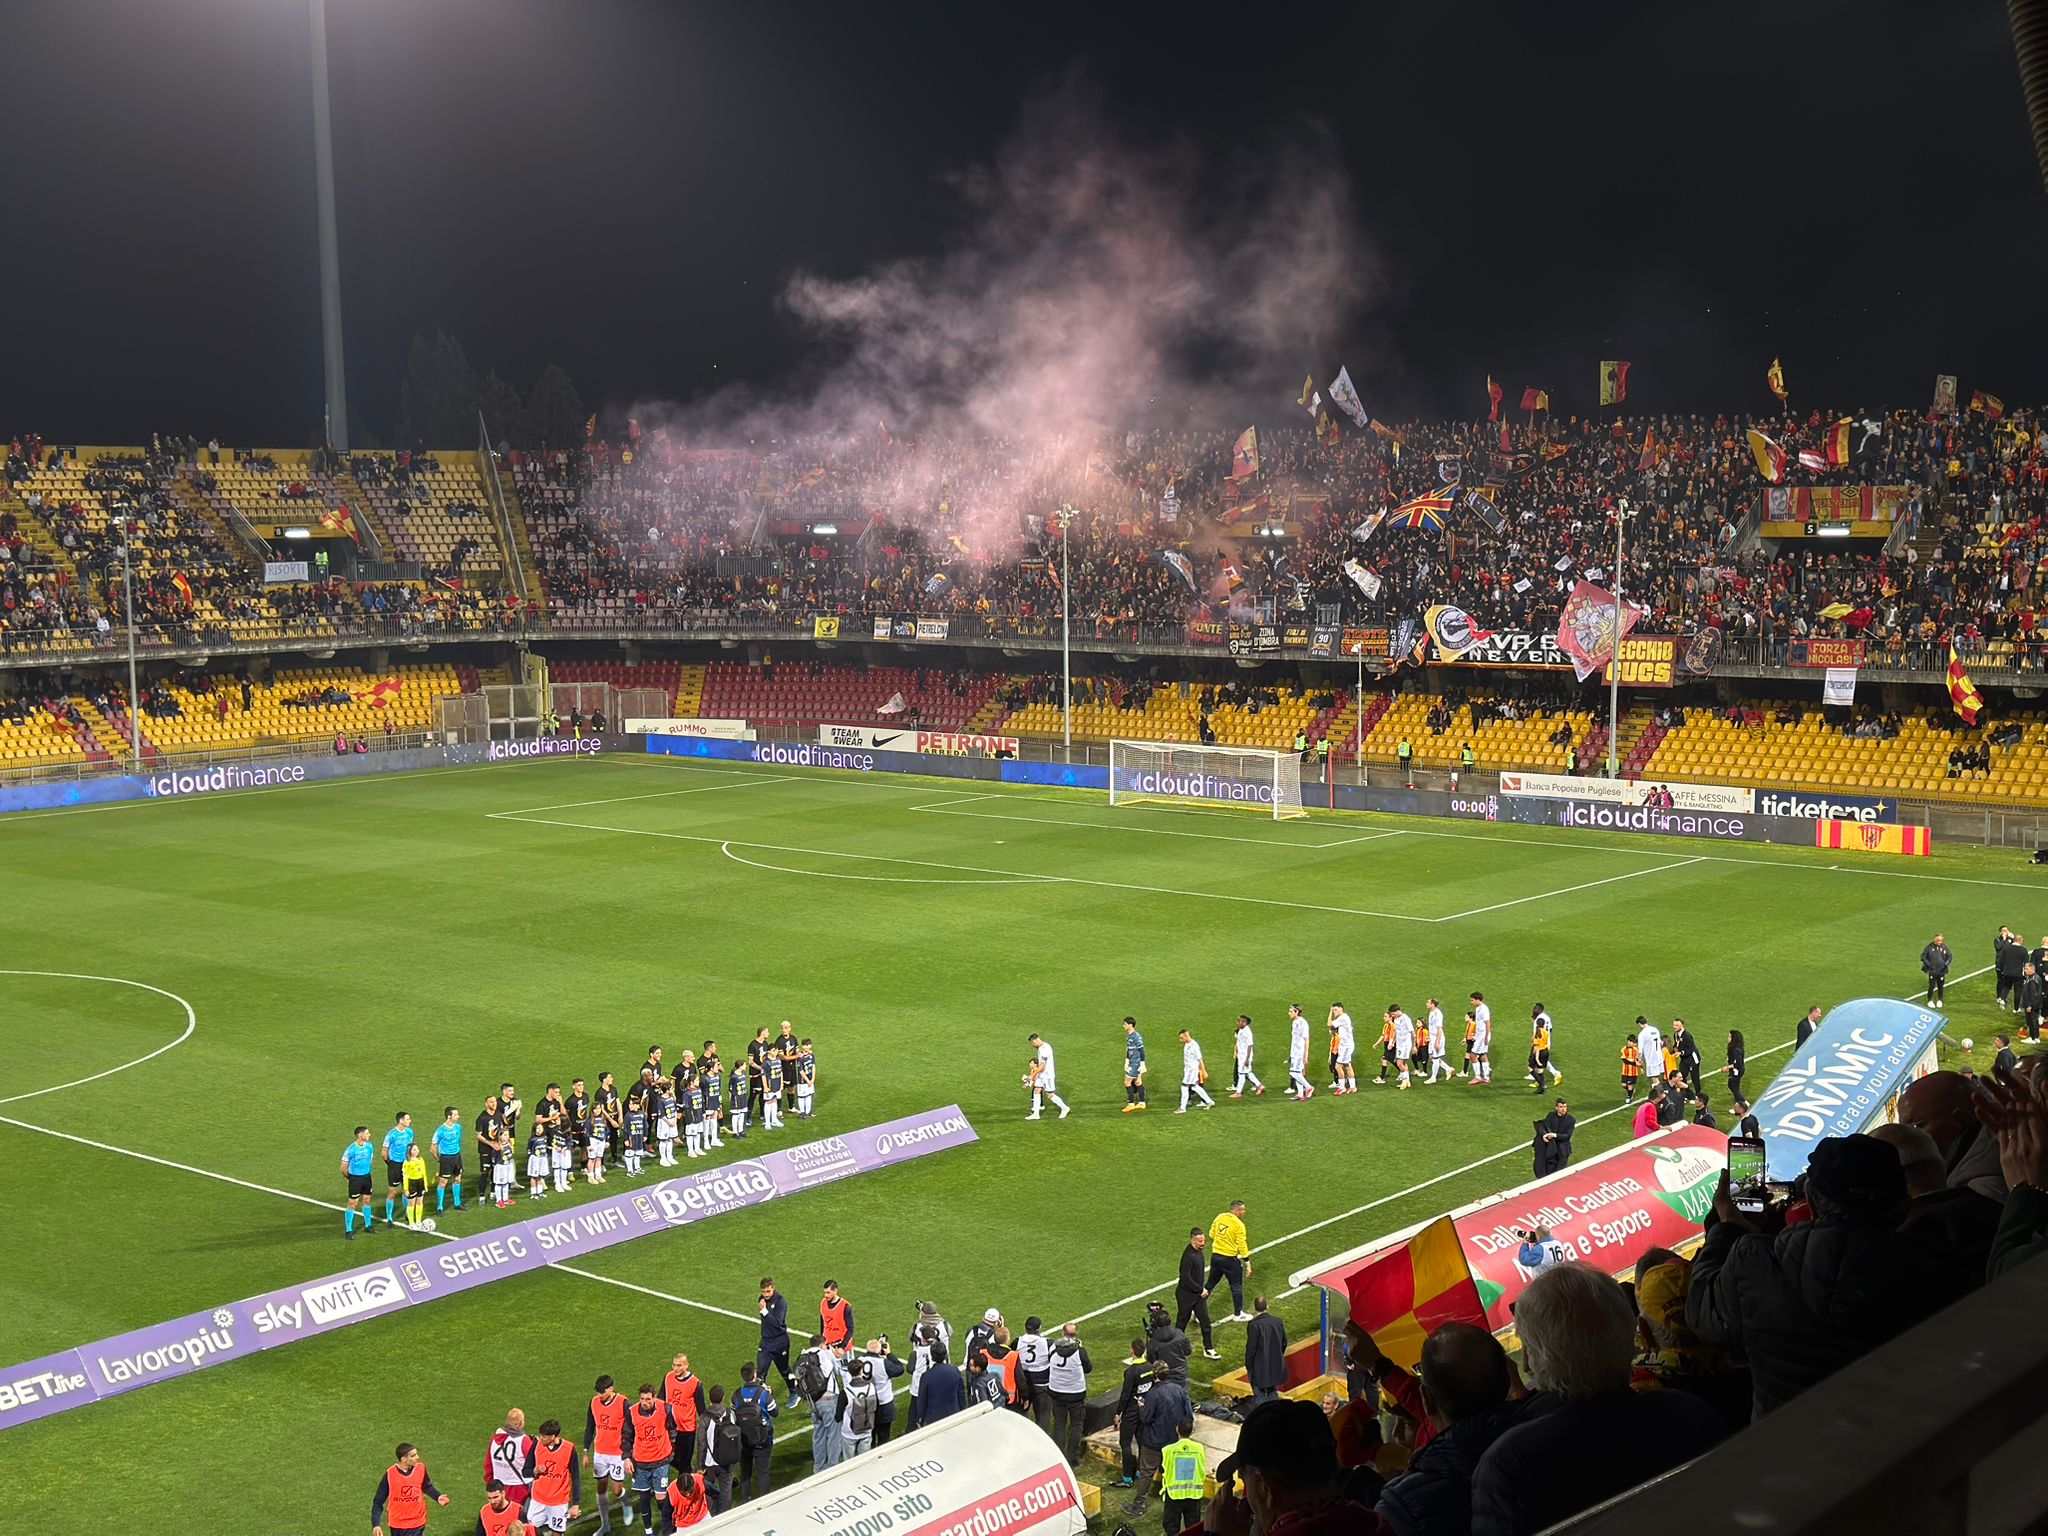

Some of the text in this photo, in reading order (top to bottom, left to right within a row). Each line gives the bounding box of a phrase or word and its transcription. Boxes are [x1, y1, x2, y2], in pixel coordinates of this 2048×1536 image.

[1807, 525, 1813, 534] 5
[1318, 633, 1328, 643] 90
[1813, 643, 1848, 654] FORZA
[1617, 640, 1673, 661] ECCHIO
[1808, 655, 1853, 665] NICOLASI
[1605, 661, 1671, 683] CUCS
[668, 724, 707, 735] RUMMO
[495, 737, 602, 758] cloudfinance
[916, 731, 1018, 754] PETRONE
[760, 743, 873, 770] cloudfinance
[158, 765, 305, 795] cloudfinance
[1142, 771, 1284, 803] cloudfinance
[1526, 781, 1621, 797] Banca Popolare Pugliese
[1451, 799, 1486, 814] 00:00
[1699, 793, 1737, 804] MESSINA
[1574, 804, 1744, 837] cloudfinance
[1863, 1062, 1892, 1097] your
[1887, 1013, 1933, 1066] advance
[894, 1115, 969, 1148] DECATHLON
[786, 1136, 849, 1164] CATTOLICA
[794, 1150, 853, 1172] ASSICURAZIONI
[692, 1168, 723, 1185] Fratelli
[1678, 1157, 1712, 1185] Avicola
[655, 1169, 774, 1220] Beretta
[535, 1205, 629, 1250] SKY WIFI
[1470, 1223, 1527, 1256] Dalla
[1516, 1206, 1573, 1230] Valle
[1564, 1177, 1642, 1214] Caudina
[1577, 1208, 1652, 1255] e Sapore
[438, 1235, 528, 1279] SERIE C
[1548, 1245, 1563, 1263] 16
[252, 1281, 363, 1333] sky wifi
[1026, 1344, 1036, 1363] 3
[494, 1440, 516, 1463] 20
[806, 1459, 944, 1525] visita il nostro
[893, 1494, 933, 1521] sito
